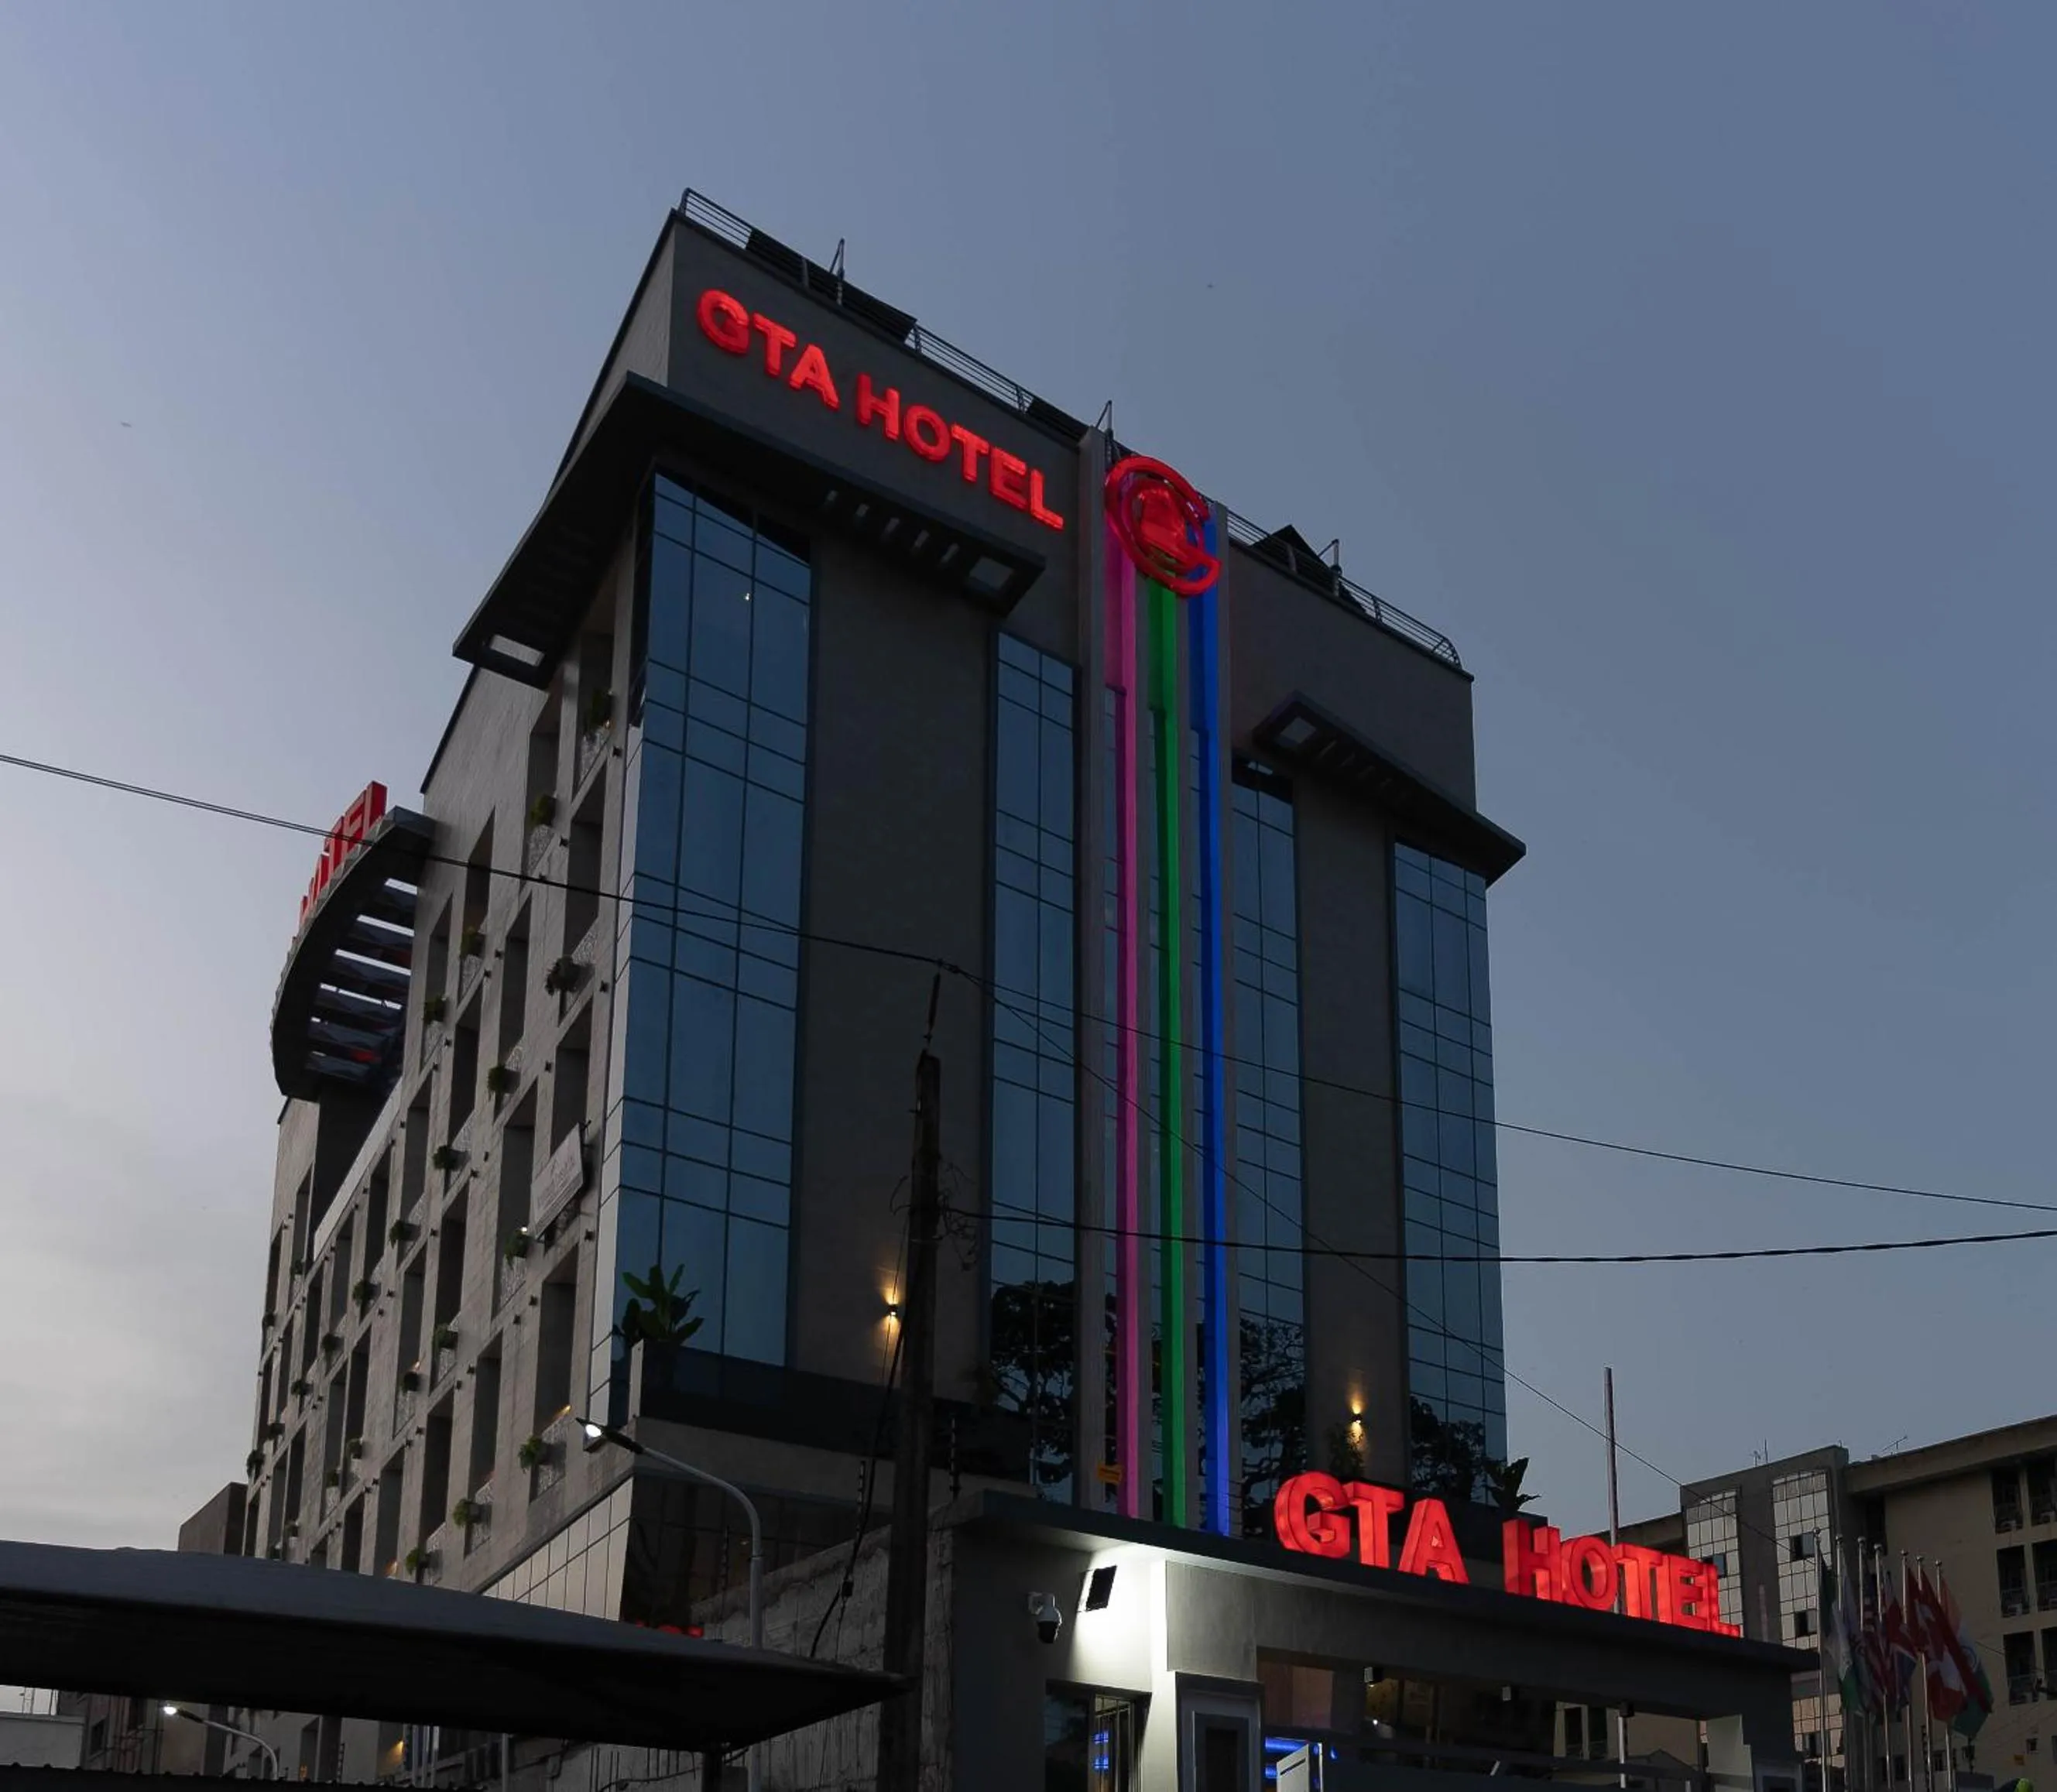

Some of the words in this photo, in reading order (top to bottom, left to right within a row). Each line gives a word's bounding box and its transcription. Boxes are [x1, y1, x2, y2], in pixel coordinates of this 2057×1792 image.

[697, 289, 840, 411] GTA
[856, 373, 1064, 532] HOTEL
[1274, 1471, 1470, 1585] GTA
[1502, 1520, 1742, 1639] HOTEL
